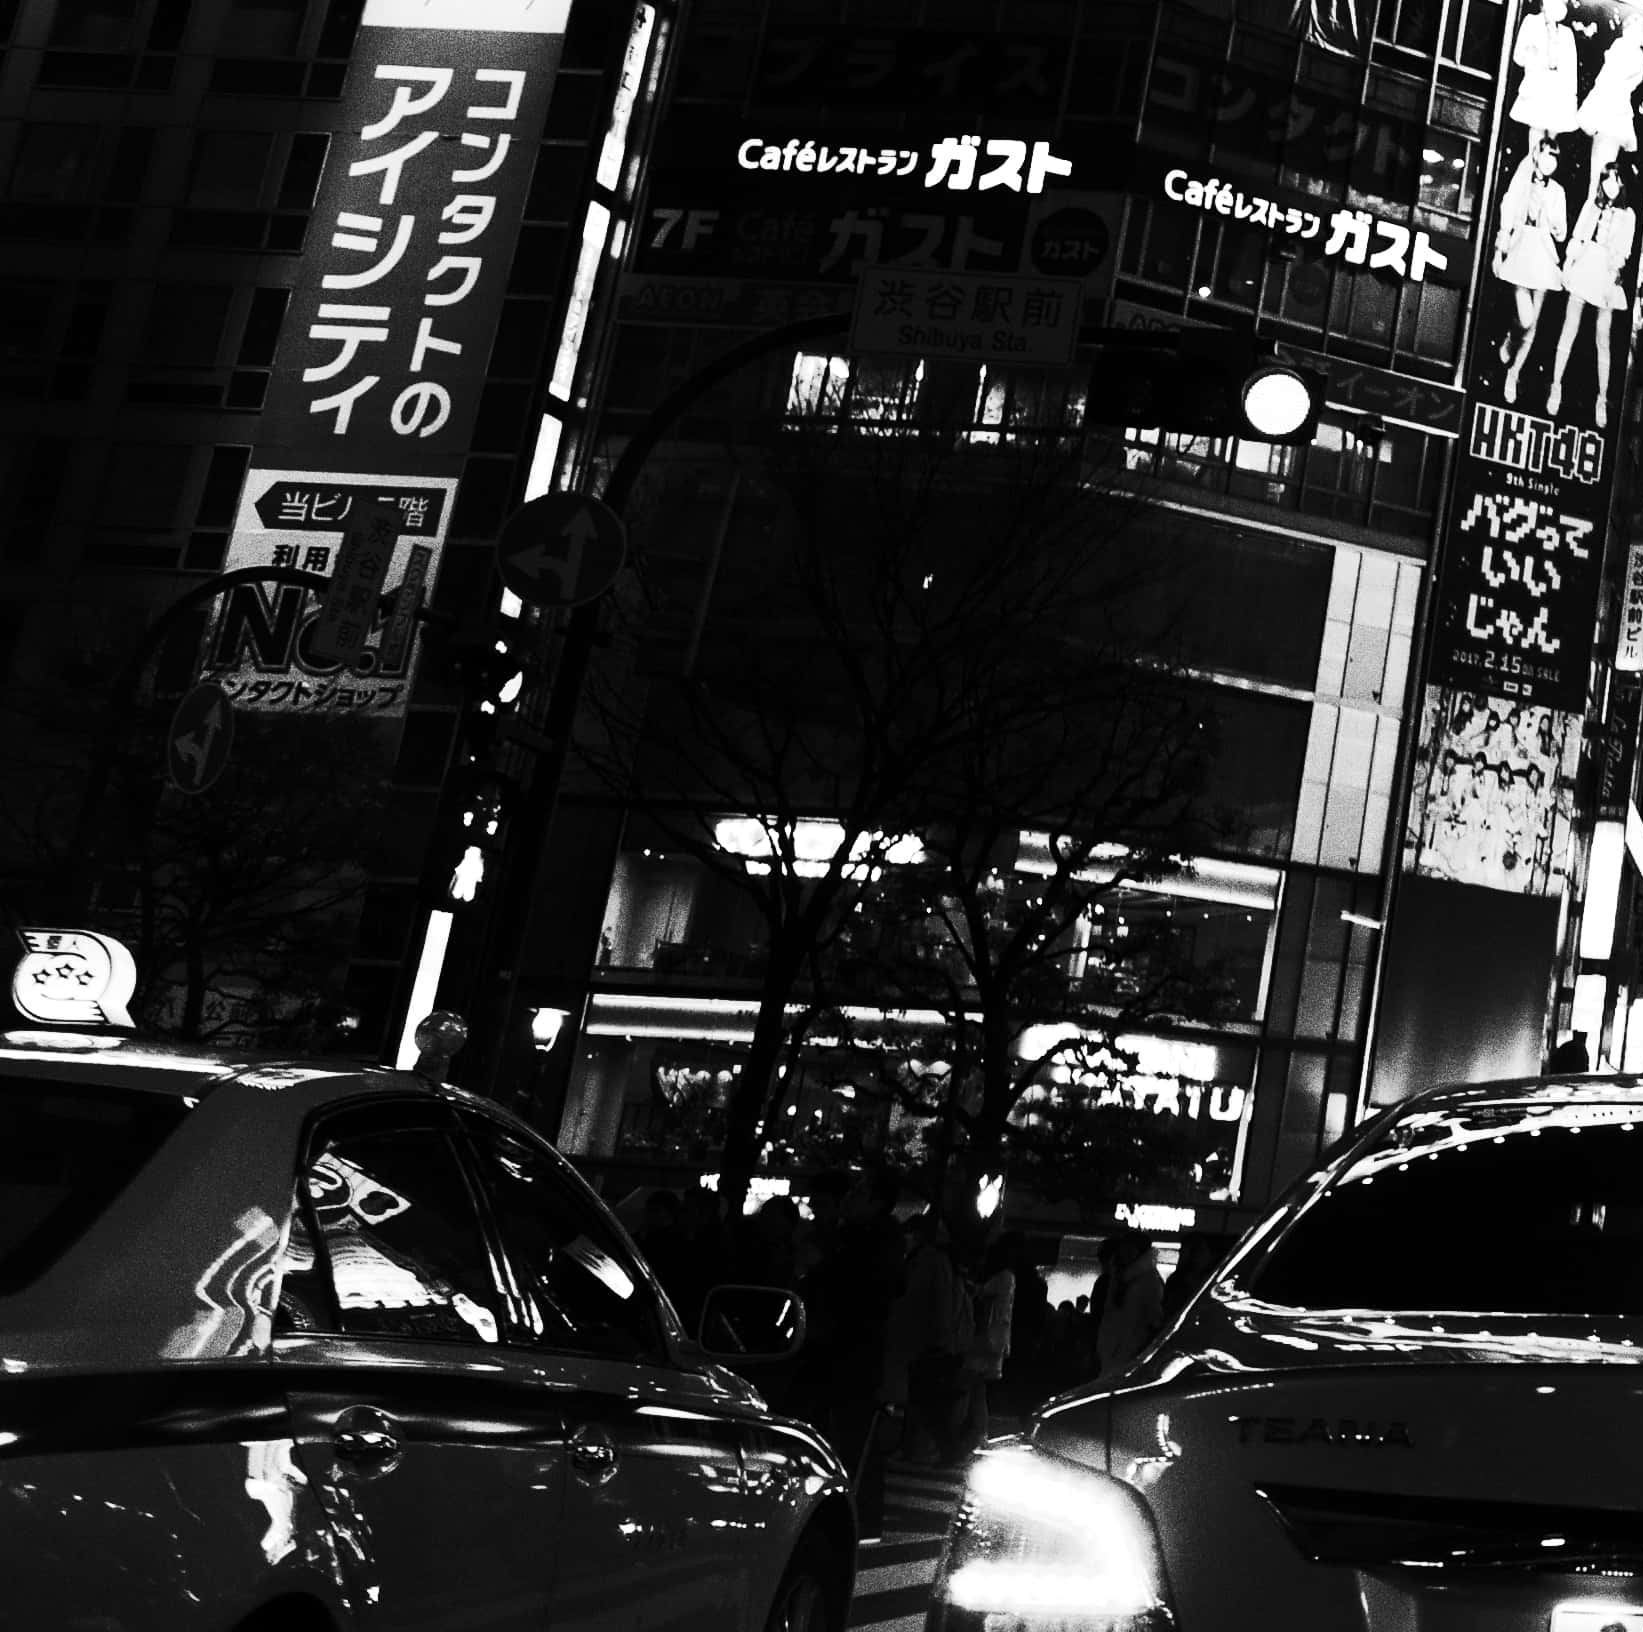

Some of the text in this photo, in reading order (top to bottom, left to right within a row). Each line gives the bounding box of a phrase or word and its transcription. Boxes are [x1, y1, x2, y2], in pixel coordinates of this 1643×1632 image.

[922, 134, 1073, 195] ガスト
[302, 65, 453, 435] アイシティ
[390, 69, 525, 438] コンタクトの
[650, 208, 720, 249] 7F
[1324, 208, 1448, 283] ガスト
[872, 276, 1066, 330] 渋谷駅前
[897, 324, 984, 352] Shibuya
[1470, 401, 1604, 485] HKT48
[1505, 471, 1560, 497] 9th Single
[1459, 493, 1594, 560] バグって
[1480, 545, 1561, 598] いい
[1466, 593, 1561, 655] じゃん
[218, 679, 403, 708] ンタクトショップ
